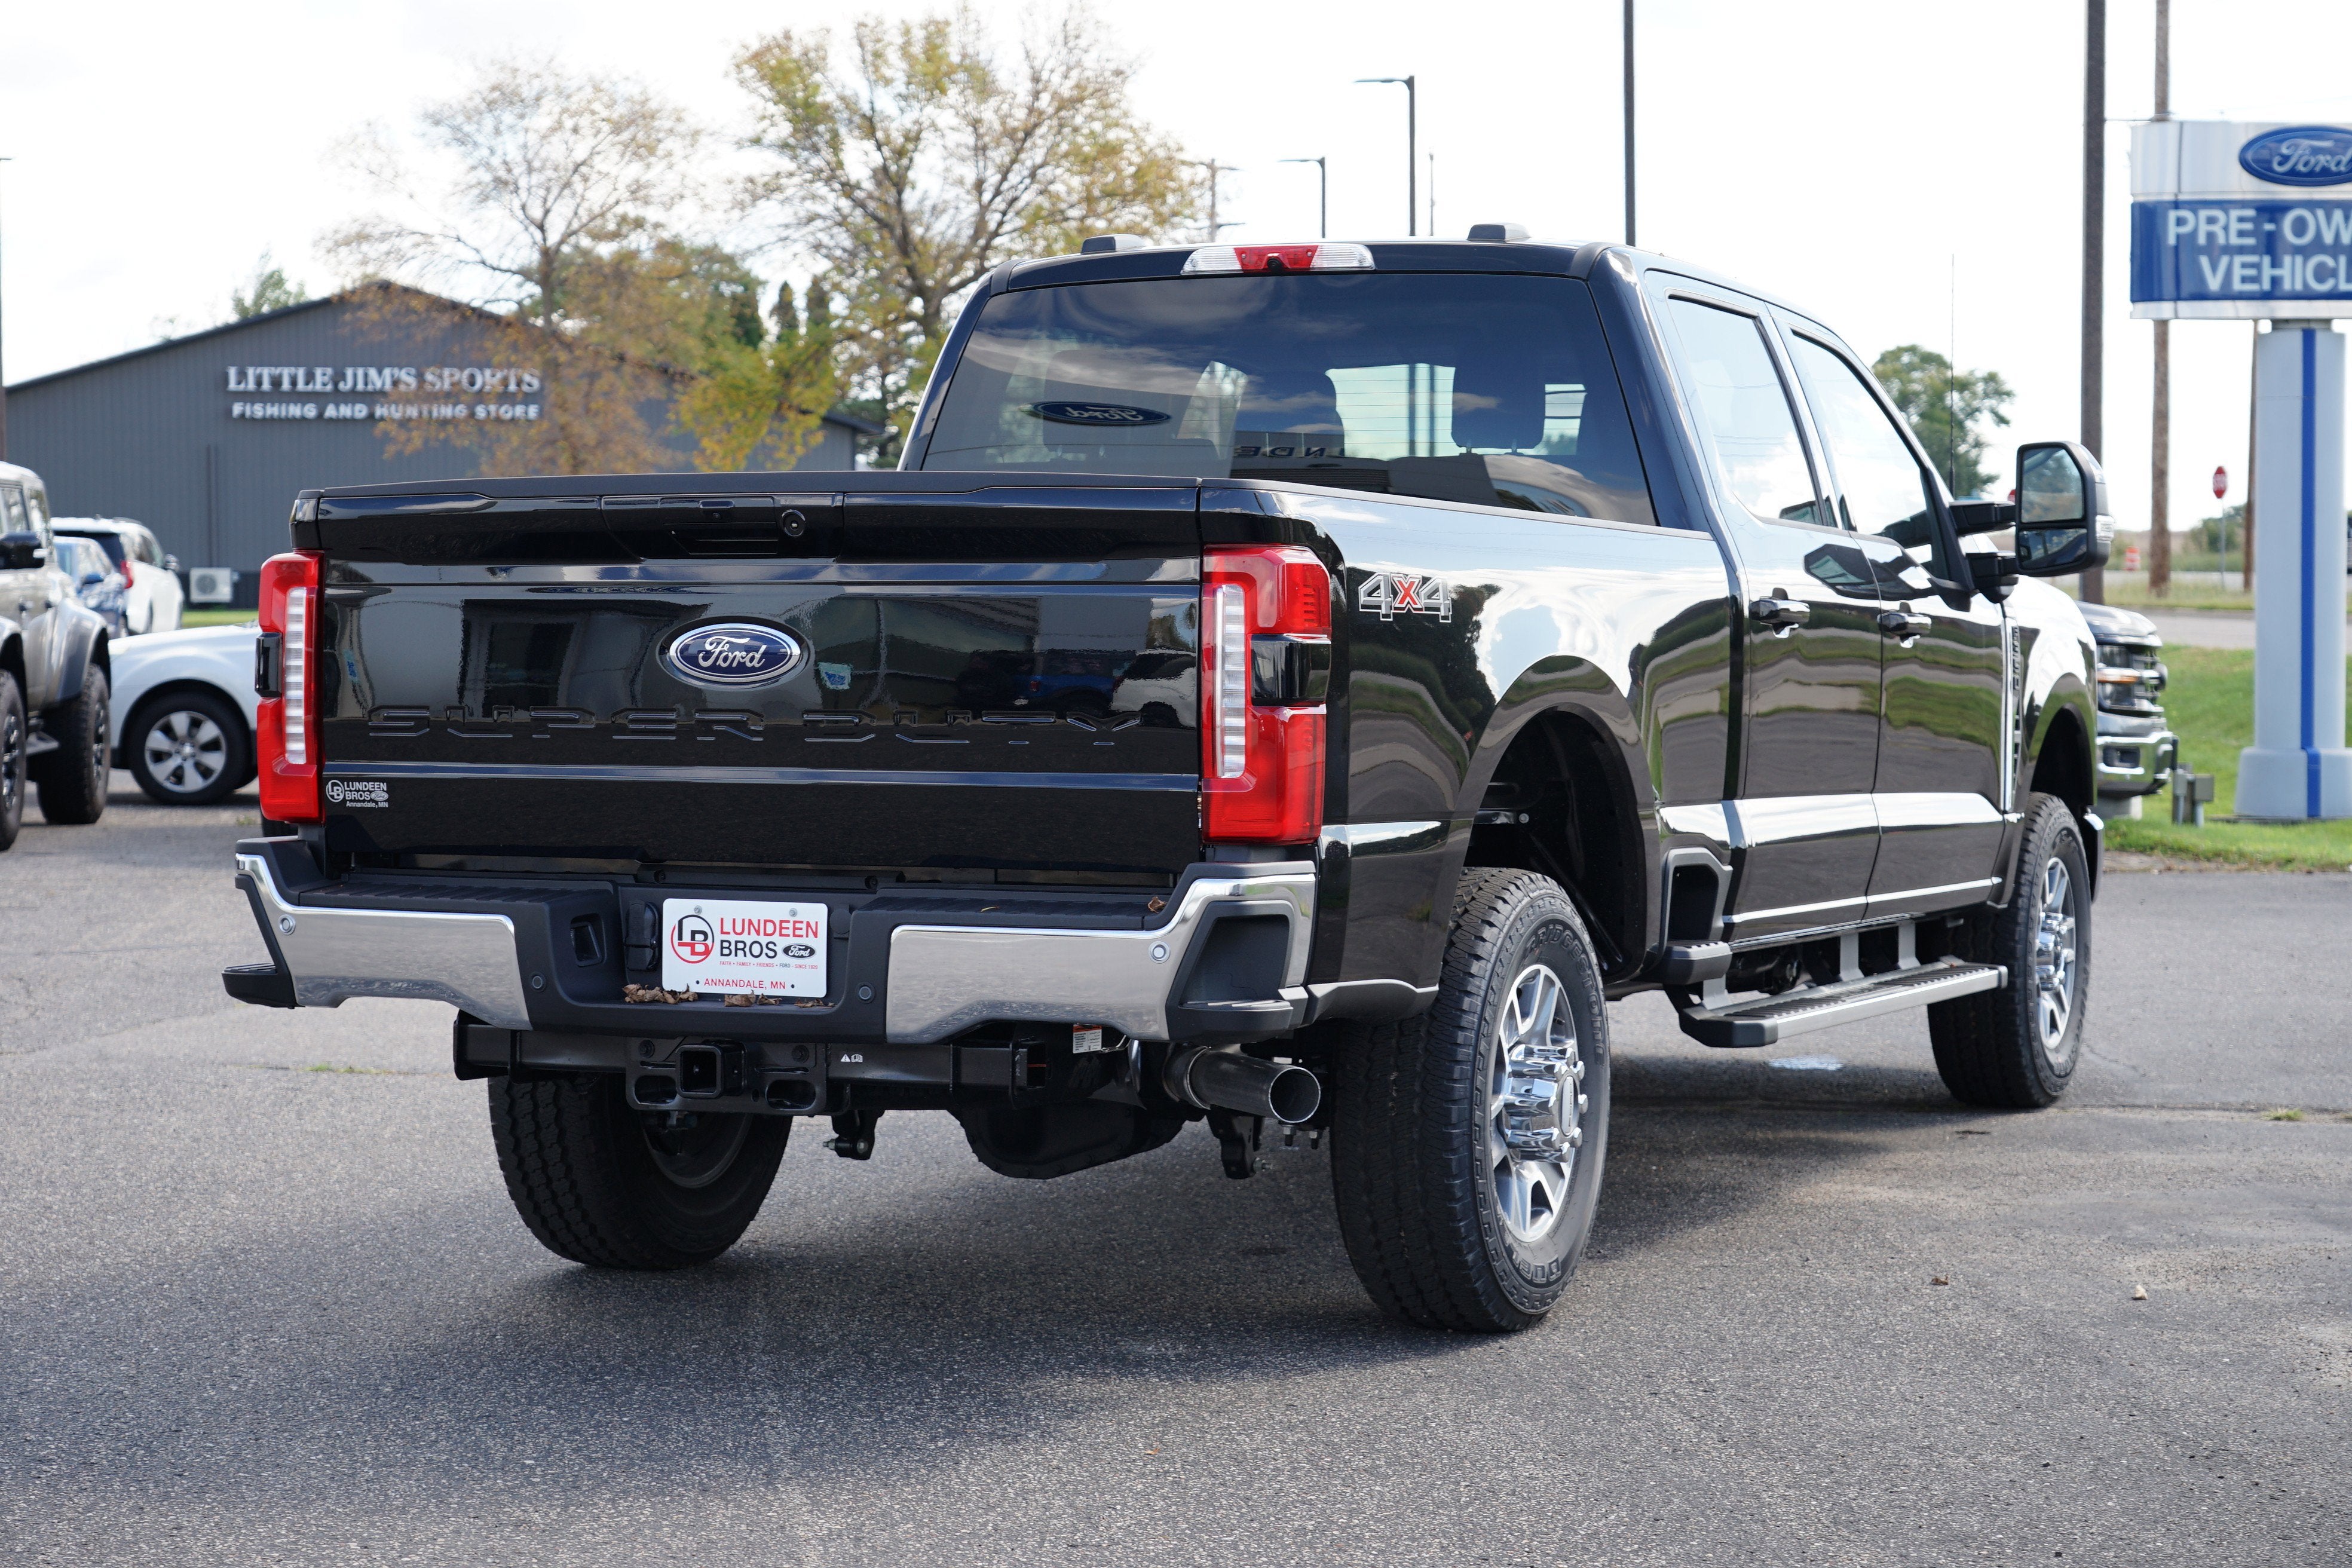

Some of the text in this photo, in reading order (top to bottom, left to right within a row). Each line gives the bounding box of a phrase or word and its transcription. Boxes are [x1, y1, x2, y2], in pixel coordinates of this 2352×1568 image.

[2273, 137, 2352, 174] Ford
[227, 366, 540, 393] LITTLE JIM'S SPORTS
[232, 402, 539, 420] FISHING AND HUNTING STORE
[698, 635, 768, 668] Ford
[368, 705, 1142, 746] SUPER DUTY
[344, 782, 387, 791] LUNDEEN
[345, 791, 371, 800] BROS
[720, 917, 819, 938] LUNDEEN
[719, 939, 810, 959] BROS Ford
[704, 978, 786, 990] ANNANDALE, MN
